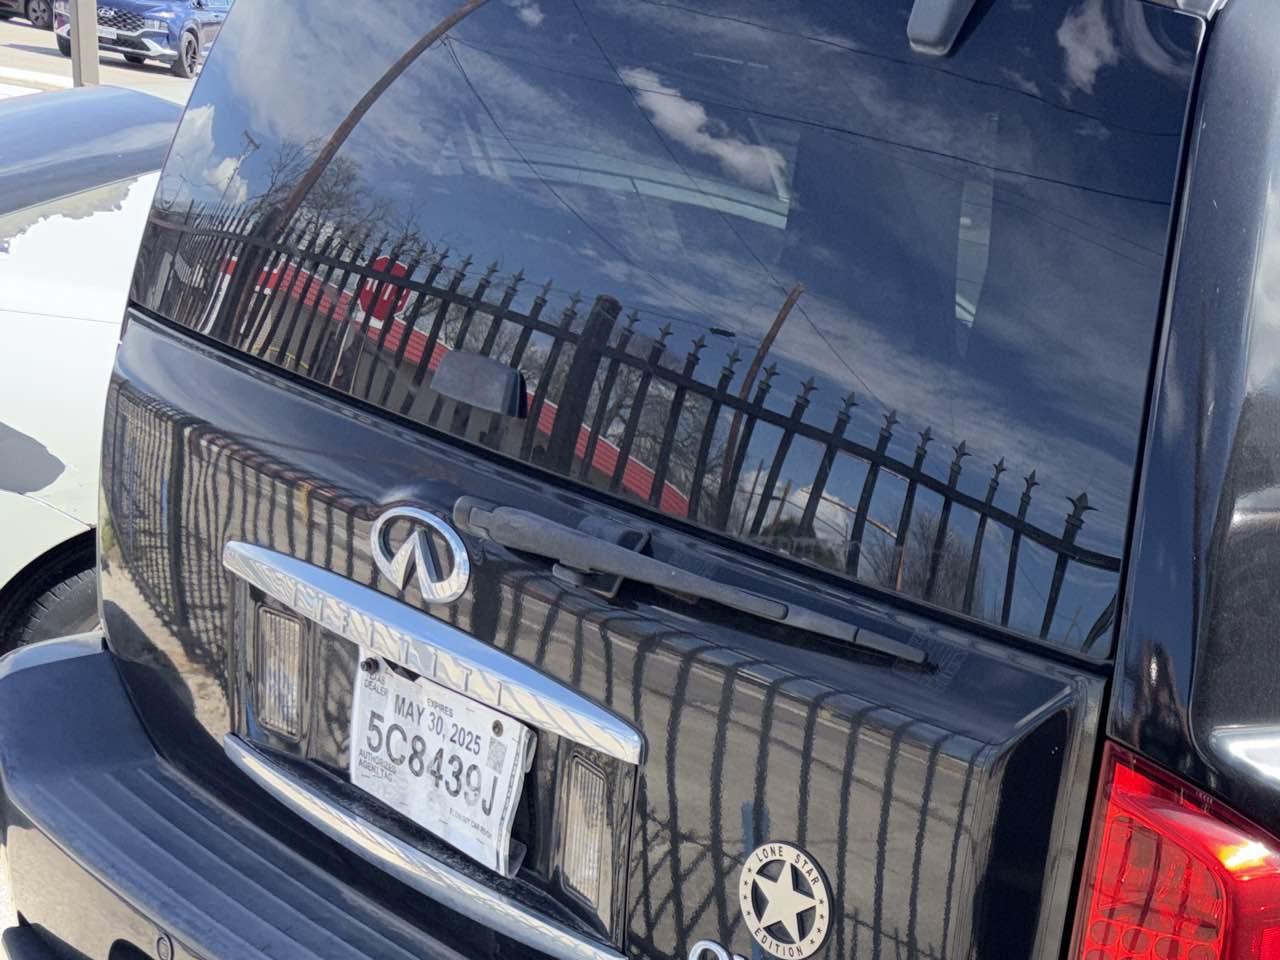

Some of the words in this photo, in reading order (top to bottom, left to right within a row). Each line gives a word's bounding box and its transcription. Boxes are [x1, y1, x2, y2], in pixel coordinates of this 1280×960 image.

[426, 697, 455, 718] EXPIRES
[394, 694, 425, 726] MAY
[428, 711, 446, 742] 30,
[450, 723, 482, 756] 2025
[366, 710, 498, 816] 5C8439J
[756, 845, 784, 862] LONE
[795, 854, 820, 886] STAR
[754, 928, 804, 958] EDITION
